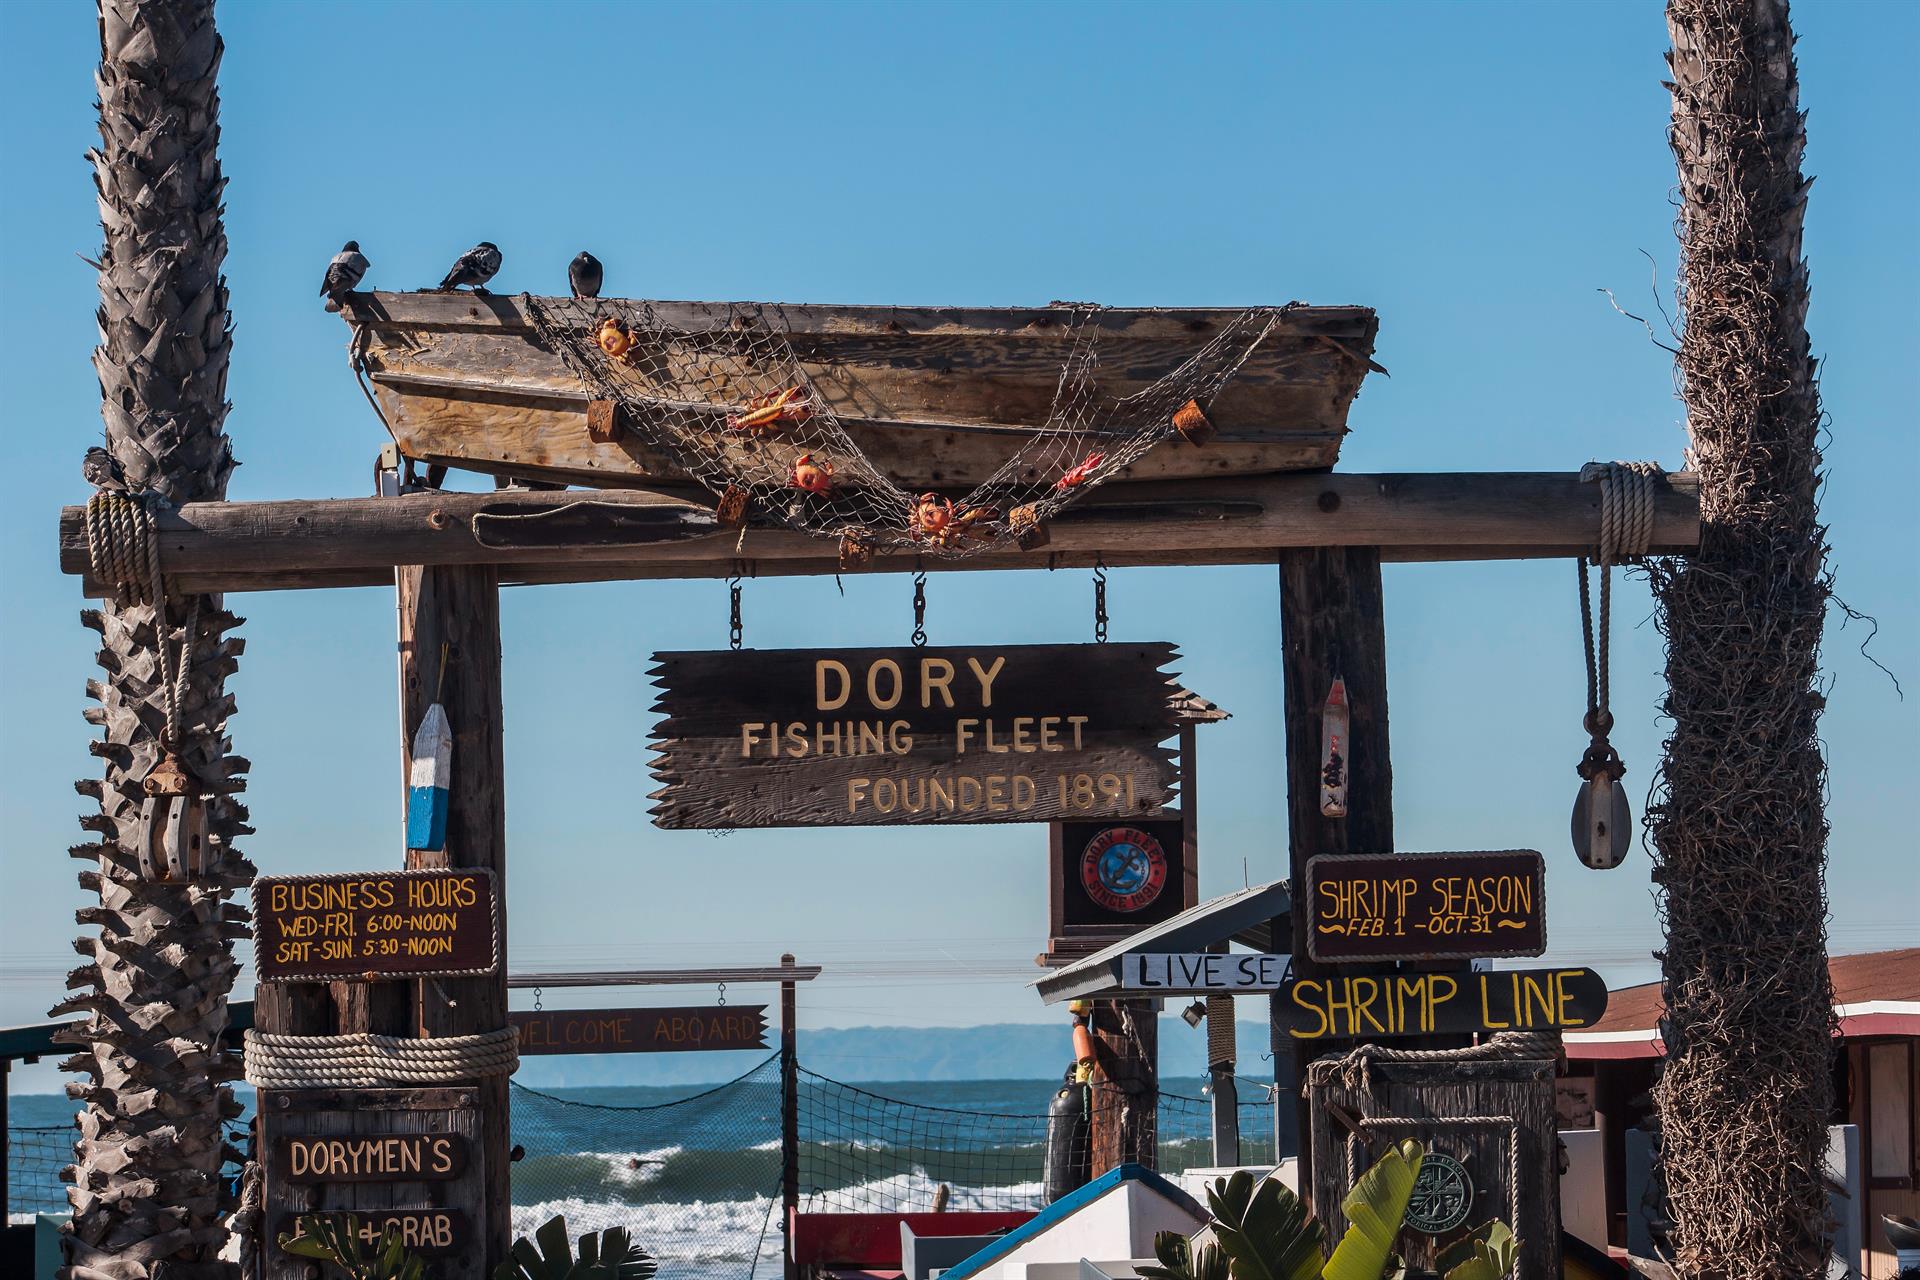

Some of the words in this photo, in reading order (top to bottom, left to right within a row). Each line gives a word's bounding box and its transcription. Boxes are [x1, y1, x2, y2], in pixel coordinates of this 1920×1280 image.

[815, 656, 1006, 711] DORY
[741, 719, 913, 758] FISHING
[956, 715, 1089, 754] FLEET
[848, 775, 1036, 814] FOUNDED
[1057, 772, 1136, 811] 1891
[1086, 831, 1113, 864] DORY
[1124, 829, 1163, 865] FLEET
[271, 880, 394, 912] BUSINESS
[408, 877, 476, 909] HOURS
[1088, 880, 1127, 908] SINCE
[1131, 882, 1159, 906] 1891
[1319, 878, 1418, 919] SHRIMP
[1429, 876, 1531, 916] SEASON
[278, 912, 357, 937] WED-FRI.
[275, 938, 357, 963] SAT-SUN.
[1139, 955, 1226, 987] LIVE
[1289, 974, 1458, 1038] SHRIMP
[1481, 971, 1584, 1029] LINE
[654, 1015, 756, 1042] ABOARD
[291, 1136, 452, 1176] DORYMEN'S
